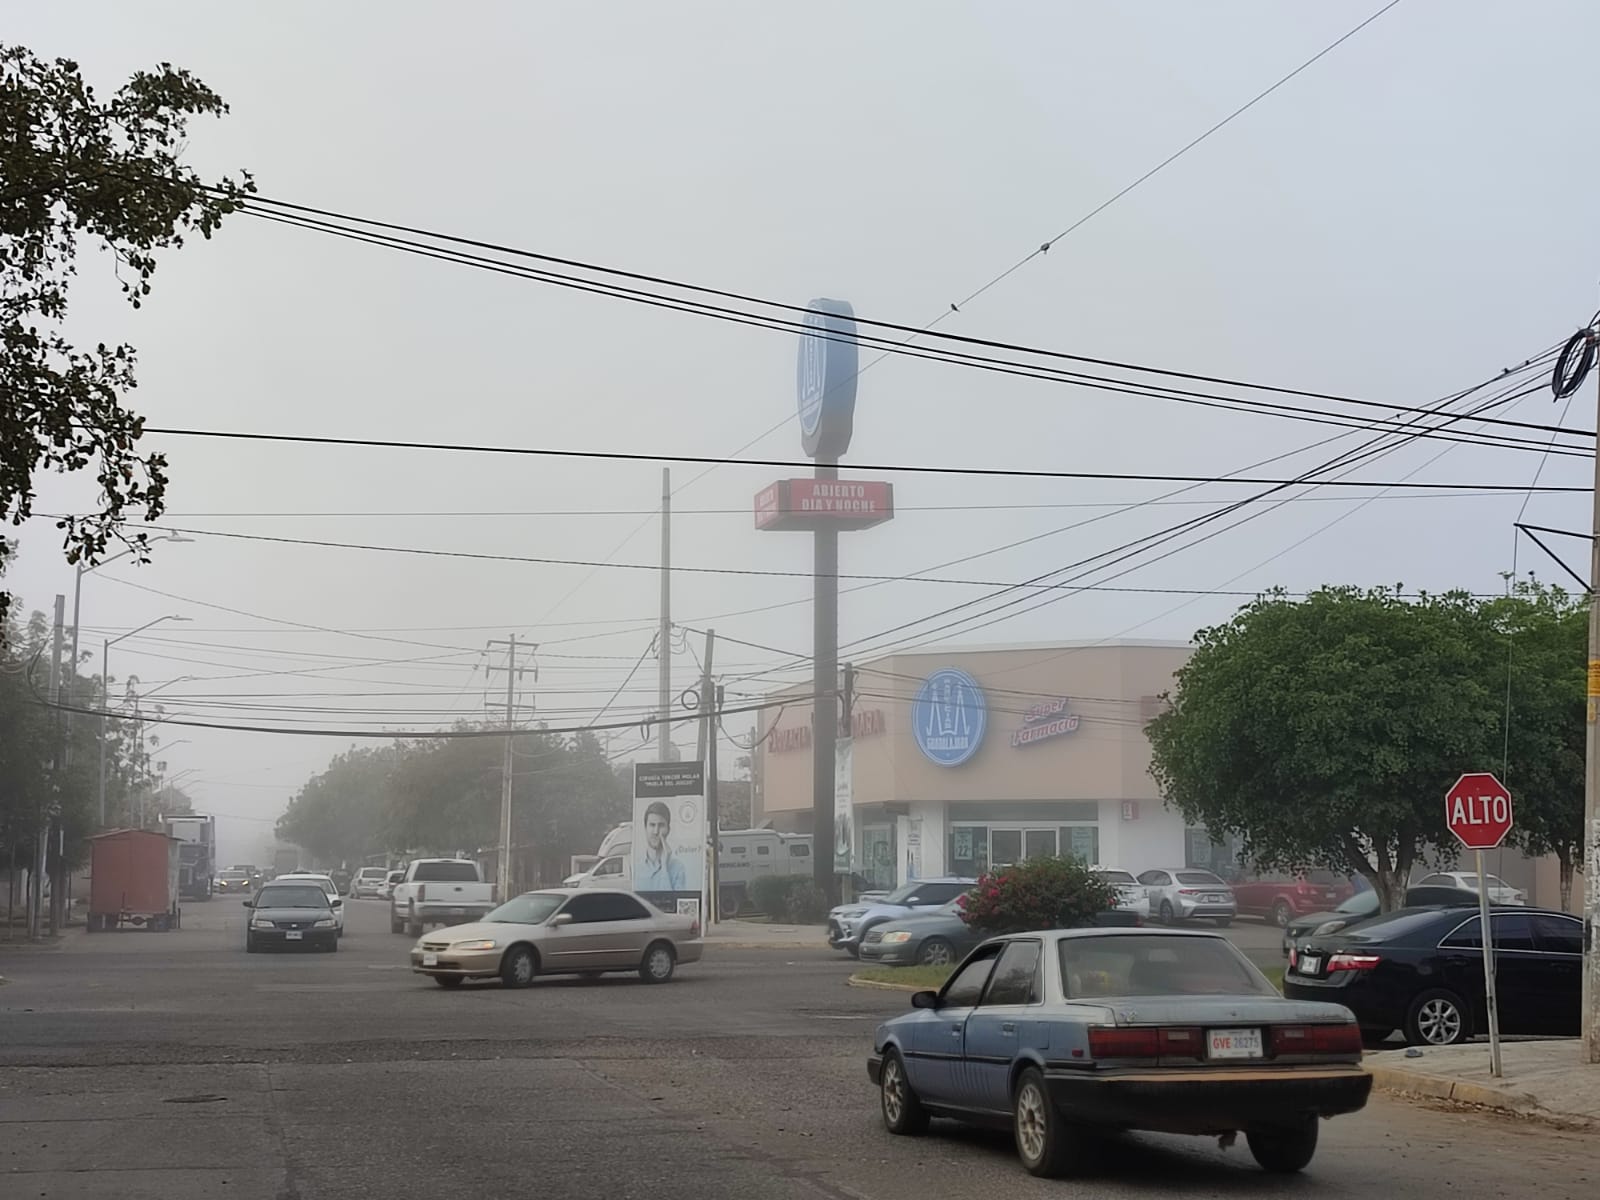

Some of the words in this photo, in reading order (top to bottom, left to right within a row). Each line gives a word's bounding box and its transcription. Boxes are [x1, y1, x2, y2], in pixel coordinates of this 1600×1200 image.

[813, 483, 865, 498] ABIERTO
[825, 498, 833, 511] Y
[835, 499, 876, 513] NOCHE
[1011, 715, 1079, 746] Farmacia
[1451, 795, 1508, 825] ALTO
[1213, 1037, 1231, 1049] GVE
